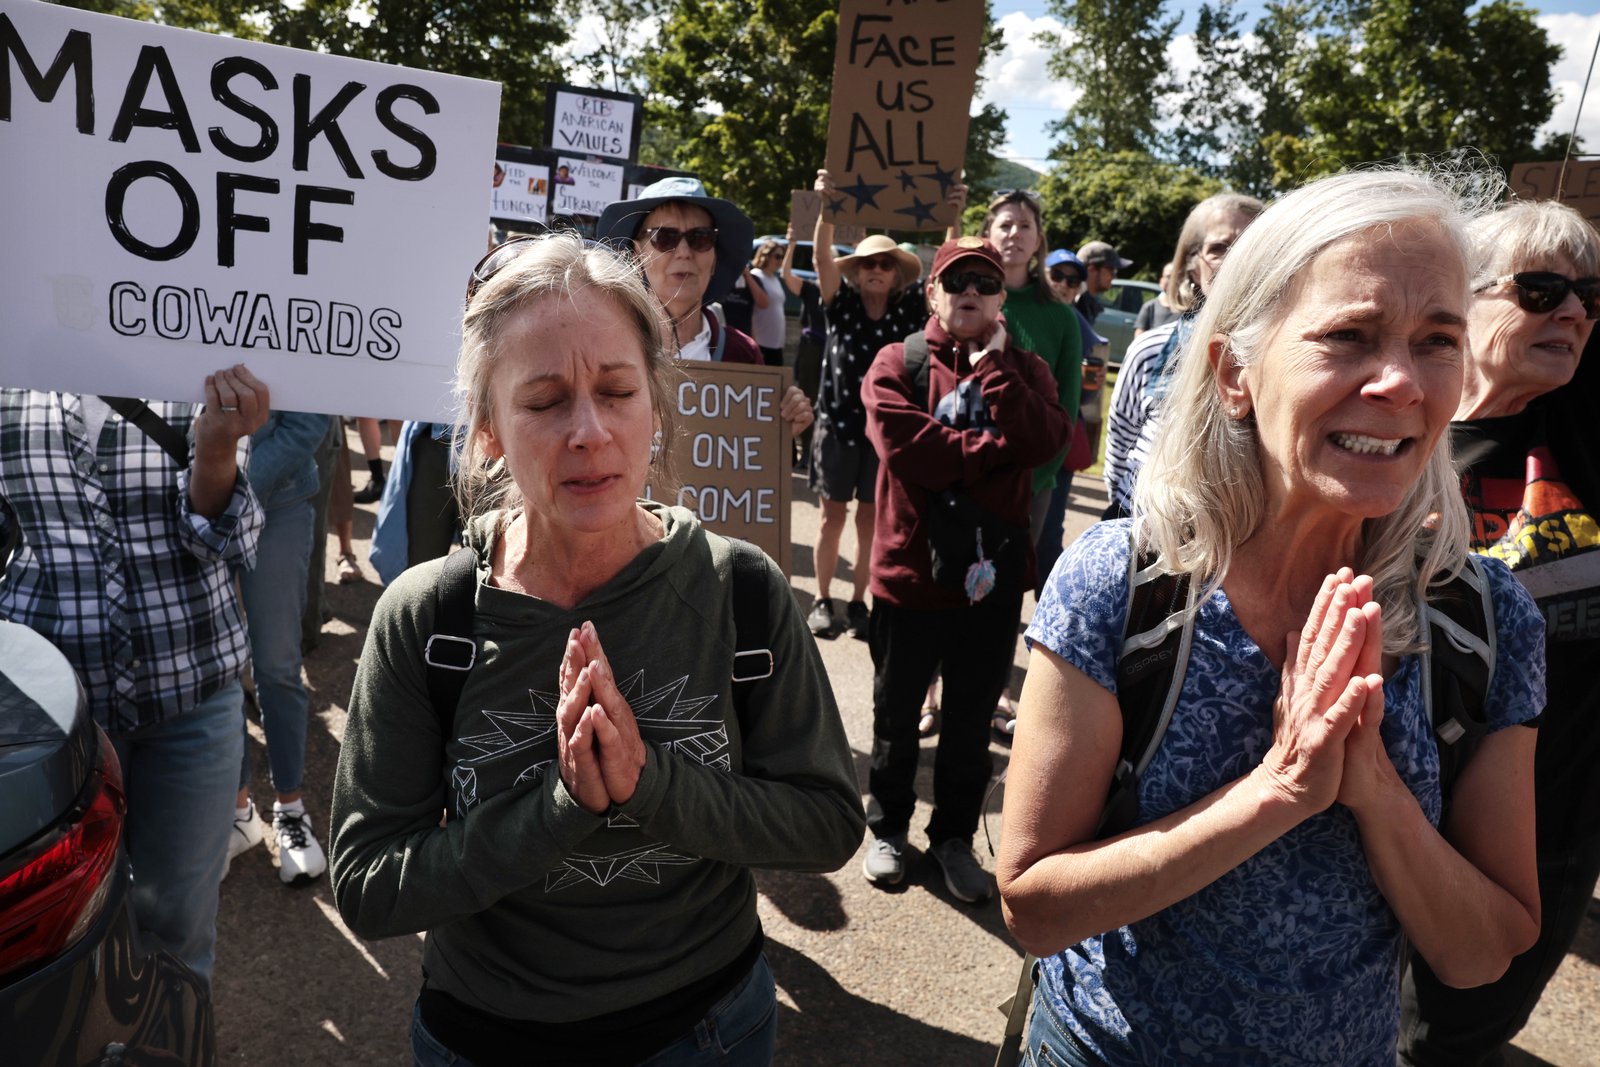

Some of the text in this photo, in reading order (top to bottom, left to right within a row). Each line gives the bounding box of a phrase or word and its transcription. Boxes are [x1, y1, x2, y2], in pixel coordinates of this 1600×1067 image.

[849, 13, 956, 68] FACE
[0, 12, 440, 181] MASKS
[559, 128, 623, 154] VALUES
[560, 111, 624, 134] AMERICAN
[845, 112, 939, 172] ALL
[565, 161, 617, 182] WELCOME
[105, 160, 355, 275] OFF
[109, 281, 402, 361] COWARDS
[677, 381, 775, 422] COME
[692, 432, 763, 471] ONE
[677, 486, 775, 524] COME
[1126, 648, 1173, 674] OSPREY
